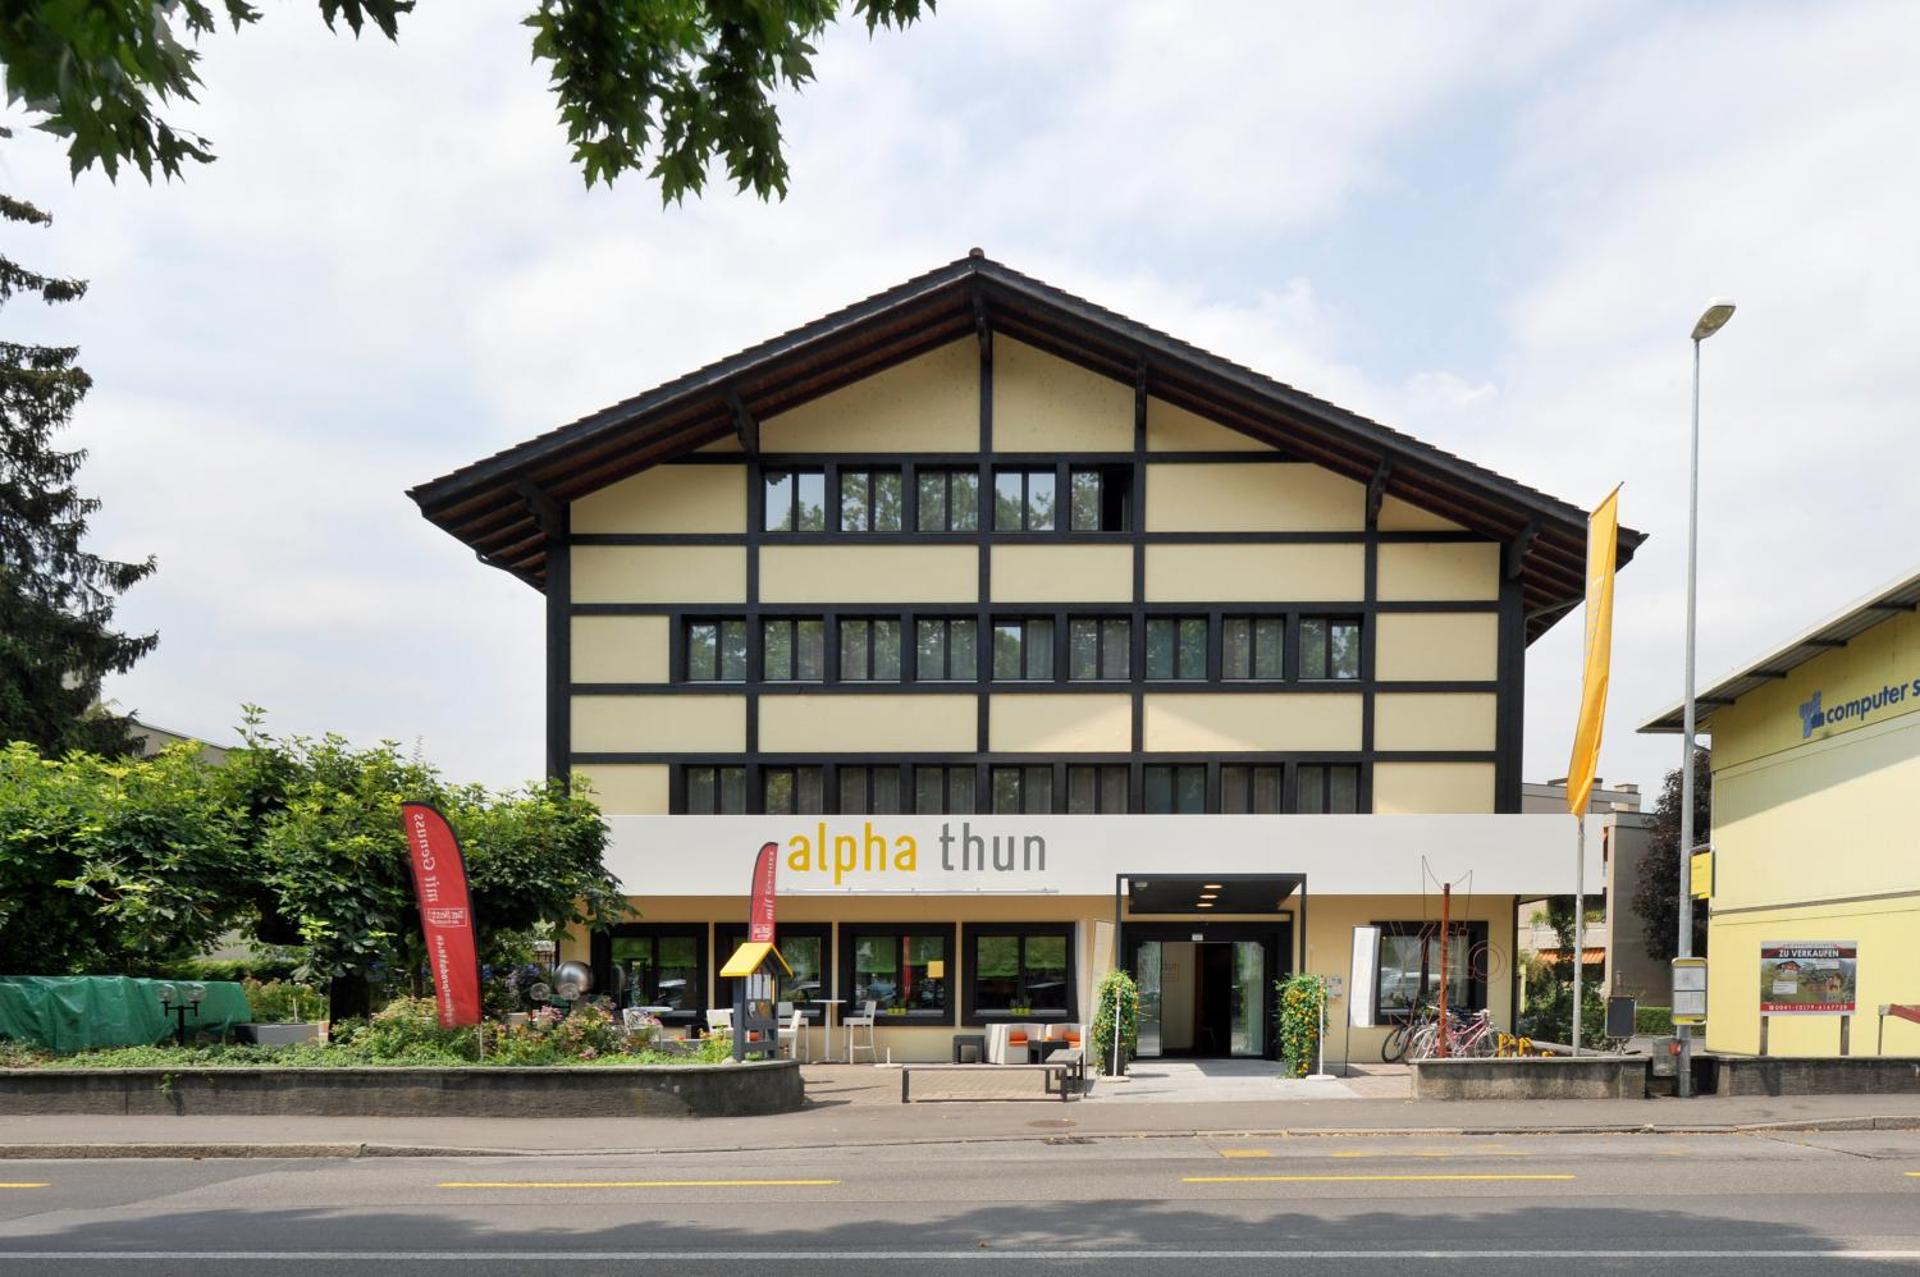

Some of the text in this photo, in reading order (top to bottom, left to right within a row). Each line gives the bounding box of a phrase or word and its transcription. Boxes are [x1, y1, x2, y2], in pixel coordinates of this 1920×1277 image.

[1827, 683, 1908, 723] computer
[787, 822, 1046, 885] alpha thun
[1778, 949, 1839, 958] ZU VERKAUFEN
